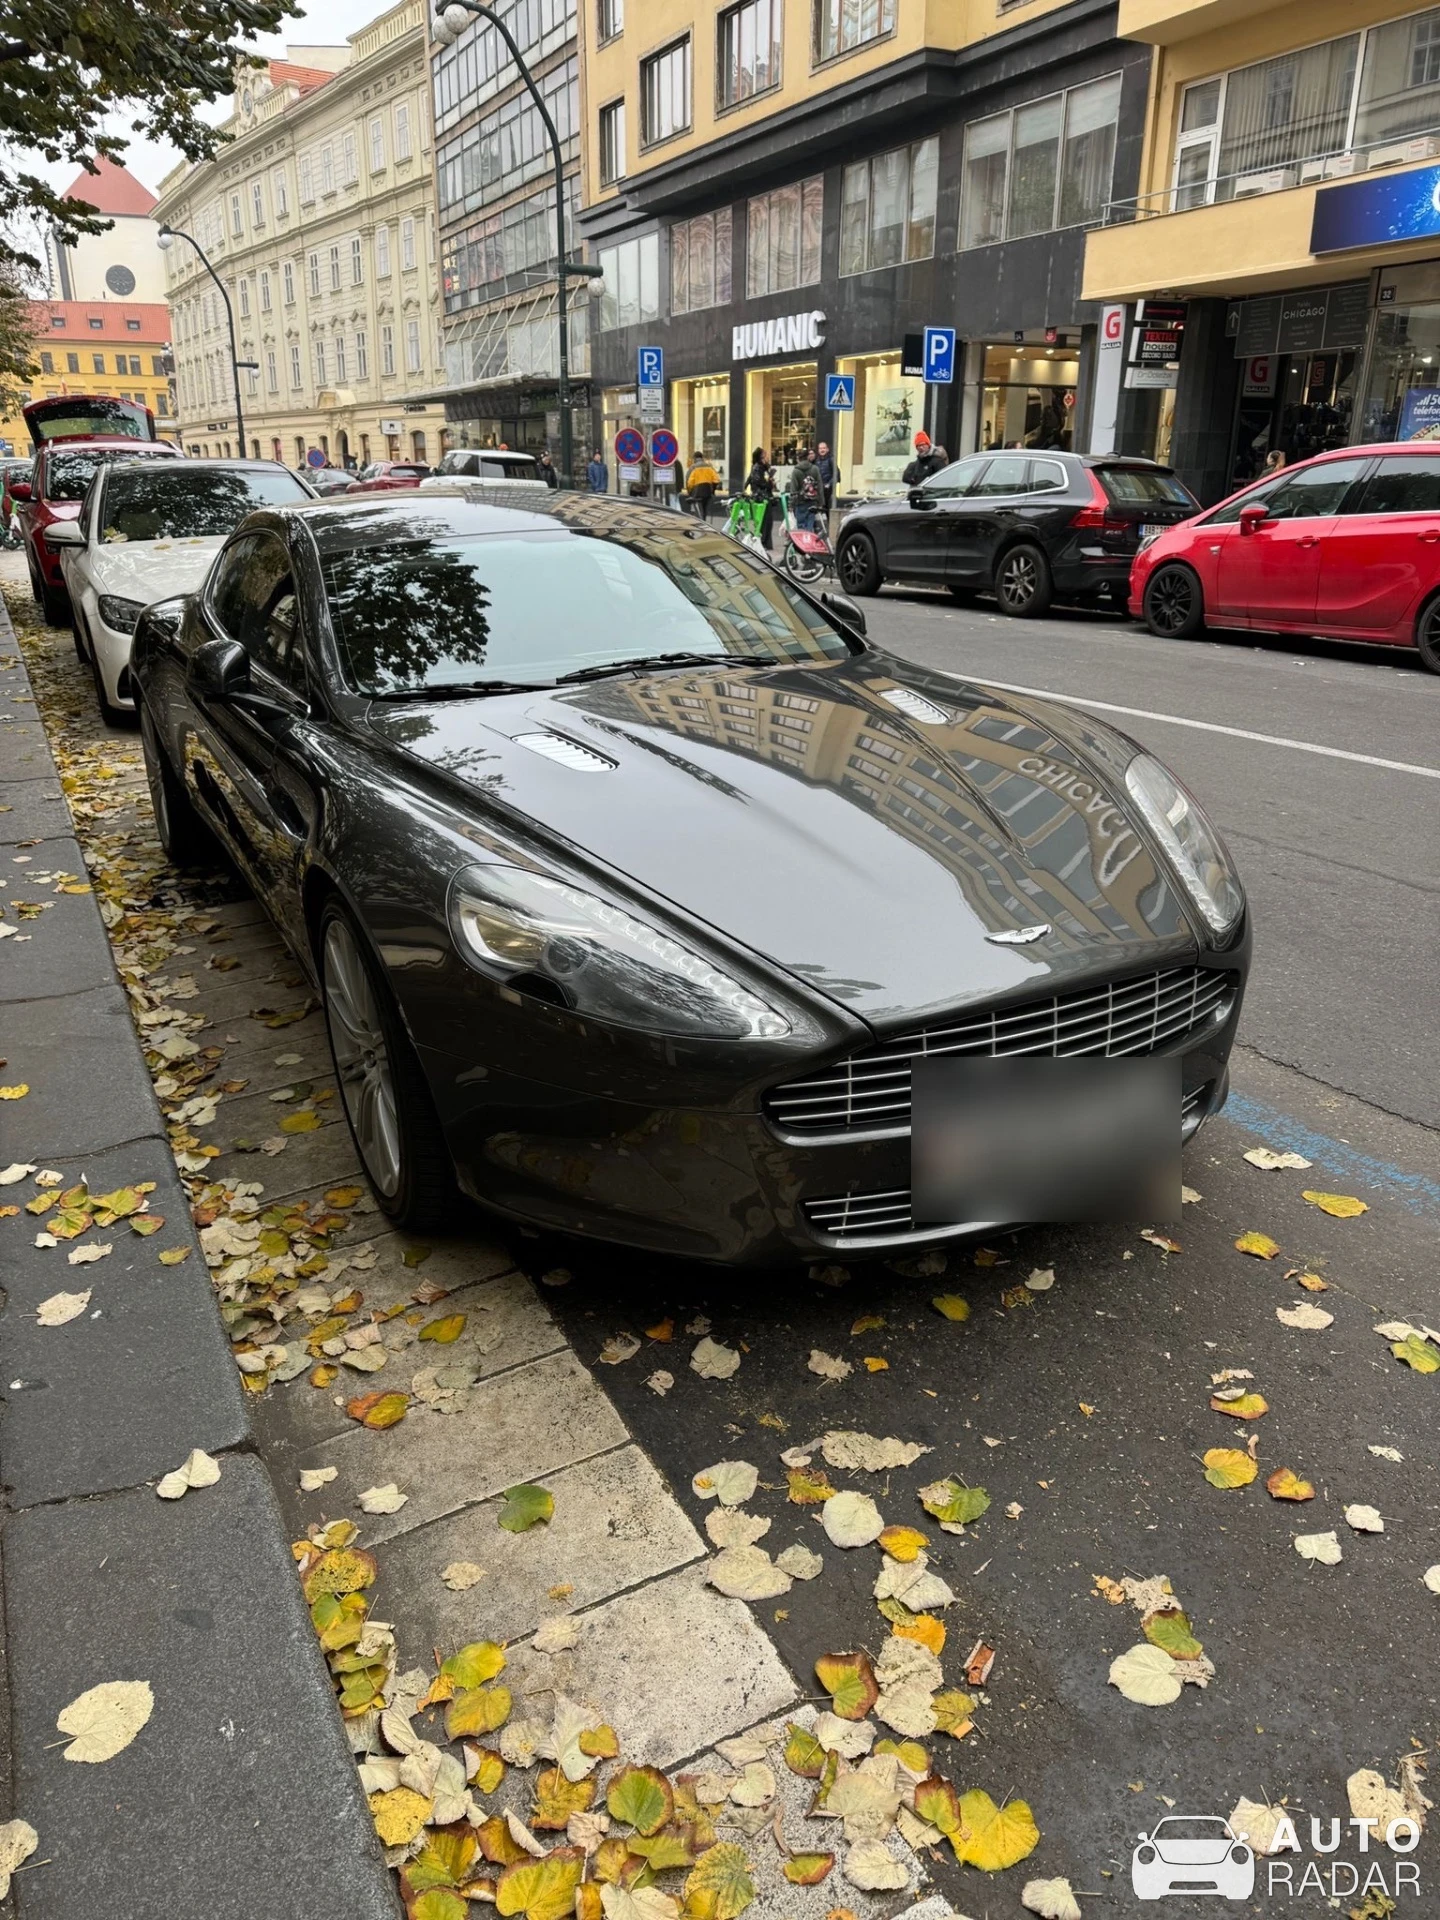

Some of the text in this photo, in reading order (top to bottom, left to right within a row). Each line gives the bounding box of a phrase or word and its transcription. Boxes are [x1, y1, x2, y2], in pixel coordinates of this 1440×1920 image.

[1382, 290, 1392, 299] 32
[1106, 311, 1121, 338] G
[1283, 306, 1325, 320] CHICAGO
[732, 309, 827, 361] HUMANIC
[1144, 331, 1178, 342] TEXTILE
[1144, 342, 1176, 351] house
[930, 333, 949, 366] P
[643, 351, 658, 374] P
[1251, 356, 1268, 383] G
